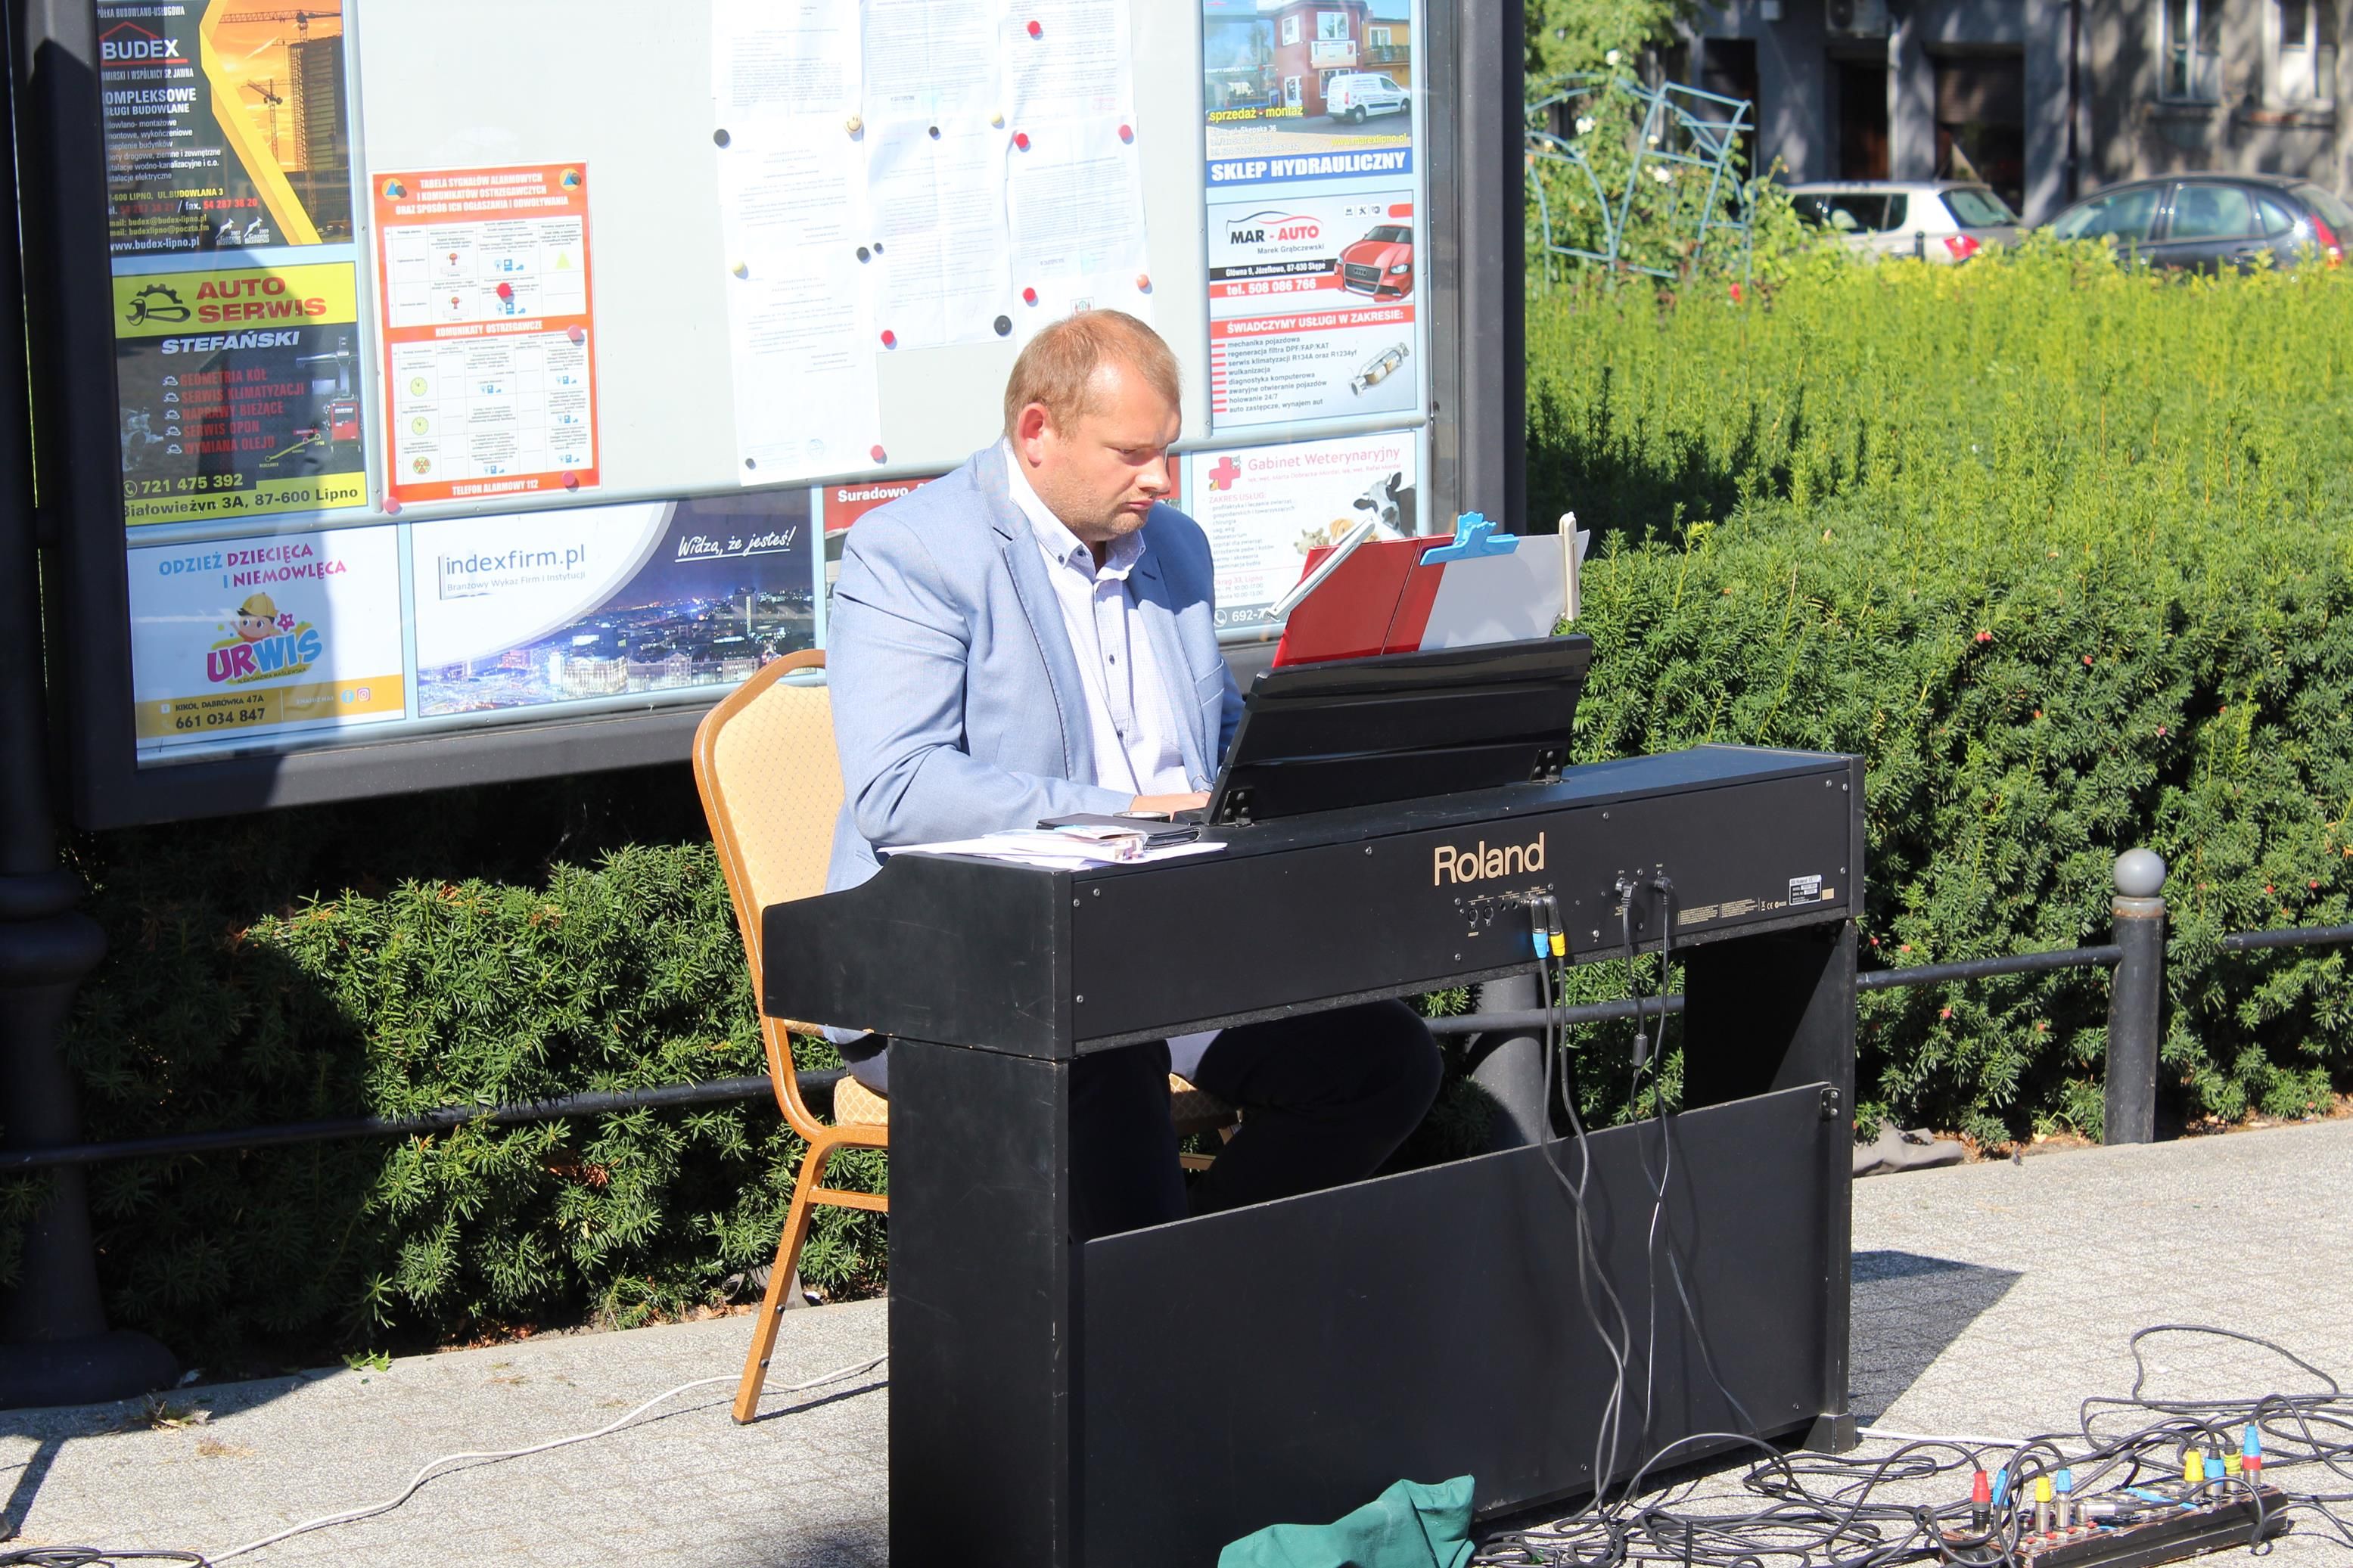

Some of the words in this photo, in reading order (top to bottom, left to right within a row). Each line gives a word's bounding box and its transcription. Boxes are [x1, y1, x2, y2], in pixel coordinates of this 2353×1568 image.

[98, 7, 115, 18] PÓŁKA
[102, 39, 179, 60] BUDEX
[131, 68, 163, 79] WSPÓLNICY
[173, 67, 194, 78] JAWNA
[104, 88, 197, 105] OMPLEKSOWE
[104, 106, 130, 116] SŁUGI
[132, 103, 190, 116] BUDOWLANE
[1209, 107, 1257, 123] sprzedaż
[1265, 106, 1304, 118] montaż
[139, 119, 177, 128] montażowe
[141, 128, 193, 140] wykończeniowe
[1331, 133, 1408, 146] www.marexlipno.pl
[139, 140, 173, 151] budynków
[157, 151, 179, 159] ziemne
[185, 147, 221, 158] zewnętrzne
[135, 160, 202, 170] wodno-kanalizacyjne
[1211, 160, 1267, 182] SKLEP
[1270, 152, 1406, 178] HYDRAULICZNY
[135, 172, 172, 182] elektryczne
[420, 178, 447, 189] TABELA
[448, 175, 490, 188] SYGNAŁÓW
[490, 172, 543, 185] ALARMOWYCH
[157, 188, 218, 200] UL.BUDOWLANA
[219, 188, 224, 197] 3
[421, 188, 479, 201] KOMUNIKATÓW
[480, 185, 547, 198] OSTRZEGAWCZYCH
[185, 200, 201, 211] fax.
[203, 200, 214, 209] 54
[216, 200, 231, 209] 287
[235, 199, 244, 207] 38
[247, 198, 258, 206] 20
[396, 204, 416, 216] ORAZ
[417, 201, 447, 214] SPOSÓB
[448, 201, 462, 212] ICH
[463, 198, 508, 212] OGŁASZANIA
[513, 196, 569, 209] ODWOŁYWANIA
[110, 219, 126, 228] mail:
[128, 213, 207, 225] budex@budex-lipno.pl
[110, 228, 126, 237] mail:
[129, 224, 209, 236] budexlipno@poczta.fm
[1230, 229, 1265, 244] MAR
[1277, 225, 1319, 241] AUTO
[110, 236, 200, 251] www.budex-lipno.pl
[1257, 246, 1279, 254] Marek
[1280, 244, 1325, 253] Grąbczewski
[1226, 267, 1248, 277] Główna
[1248, 267, 1254, 276] 9,
[1286, 262, 1307, 272] 87-630
[1308, 262, 1326, 272] Skępe
[197, 277, 286, 300] AUTO
[1226, 284, 1245, 296] tel.
[1248, 282, 1269, 293] 508
[1272, 280, 1292, 292] 086
[1295, 278, 1316, 290] 766
[198, 297, 327, 324] SERWIS
[435, 322, 483, 337] KOMUNIKATY
[486, 321, 543, 334] OSTRZEGAWCZE
[1226, 318, 1296, 334] ŚWIADCZYMY
[1298, 315, 1336, 328] USŁUGI
[1338, 314, 1349, 324] W
[1351, 309, 1404, 324] ZAKRESIE:
[161, 331, 300, 355] STEFAŃSKI
[1228, 338, 1264, 348] mechanika
[1265, 336, 1300, 347] pojazdowa
[1228, 347, 1267, 358] regeneracja
[1269, 346, 1285, 354] filtra
[1228, 359, 1250, 367] serwis
[1251, 355, 1291, 365] klimatyzacji
[1292, 352, 1313, 362] R134A
[1331, 349, 1357, 359] R1234yf
[180, 370, 243, 387] GEOMETRIA
[247, 368, 267, 381] KÓŁ
[1228, 366, 1271, 377] wulkanizacja
[1229, 375, 1269, 386] diagnostyka
[1270, 371, 1315, 383] komputerowa
[182, 389, 224, 404] SERWIS
[228, 383, 306, 400] KLIMATYZACJI
[1229, 386, 1258, 395] awaryjne
[1260, 383, 1295, 392] otwieranie
[1296, 380, 1327, 390] pojazdów
[1229, 395, 1263, 404] holowanie
[1245, 402, 1281, 412] zastępcze,
[1282, 399, 1311, 409] wynajem
[182, 405, 236, 421] NAPRAWY
[240, 401, 284, 416] BIEŻĄCE
[183, 423, 225, 437] SERWIS
[230, 421, 260, 434] OPON
[185, 438, 238, 455] WYMIANA
[241, 436, 275, 451] OLEJU
[1248, 456, 1301, 471] Gabinet
[1304, 446, 1400, 465] Weterynaryjny
[141, 480, 170, 494] 721
[177, 477, 208, 492] 475
[213, 474, 243, 488] 392
[452, 483, 482, 495] TELEFON
[483, 481, 525, 493] ALARMOWY
[527, 480, 538, 489] 112
[222, 495, 249, 510] 3A,
[255, 490, 310, 507] 87-600
[315, 487, 358, 502] Lipno
[838, 486, 908, 503] Suradowo
[1209, 495, 1239, 504] ZAKRES
[677, 535, 724, 557] Widzą,
[727, 537, 742, 551] że
[742, 525, 797, 557] jesteś!
[159, 551, 223, 576] ODZIEŻ
[227, 542, 313, 567] DZIECIĘCA
[446, 544, 585, 575] indexfirm.pl
[233, 559, 347, 588] NIEMOWLĘCA
[447, 581, 489, 591] Branżowy
[491, 577, 518, 588] Wykaz
[521, 576, 540, 584] Firm
[547, 571, 586, 582] Instytucji
[1232, 608, 1265, 623] 692-7
[207, 629, 323, 683] URWIS
[201, 697, 244, 709] DĄBRÓWKA
[247, 694, 264, 703] 47A
[176, 715, 200, 729] 661
[207, 711, 235, 725] 034
[239, 707, 266, 722] 847
[1434, 831, 1545, 886] Roland
